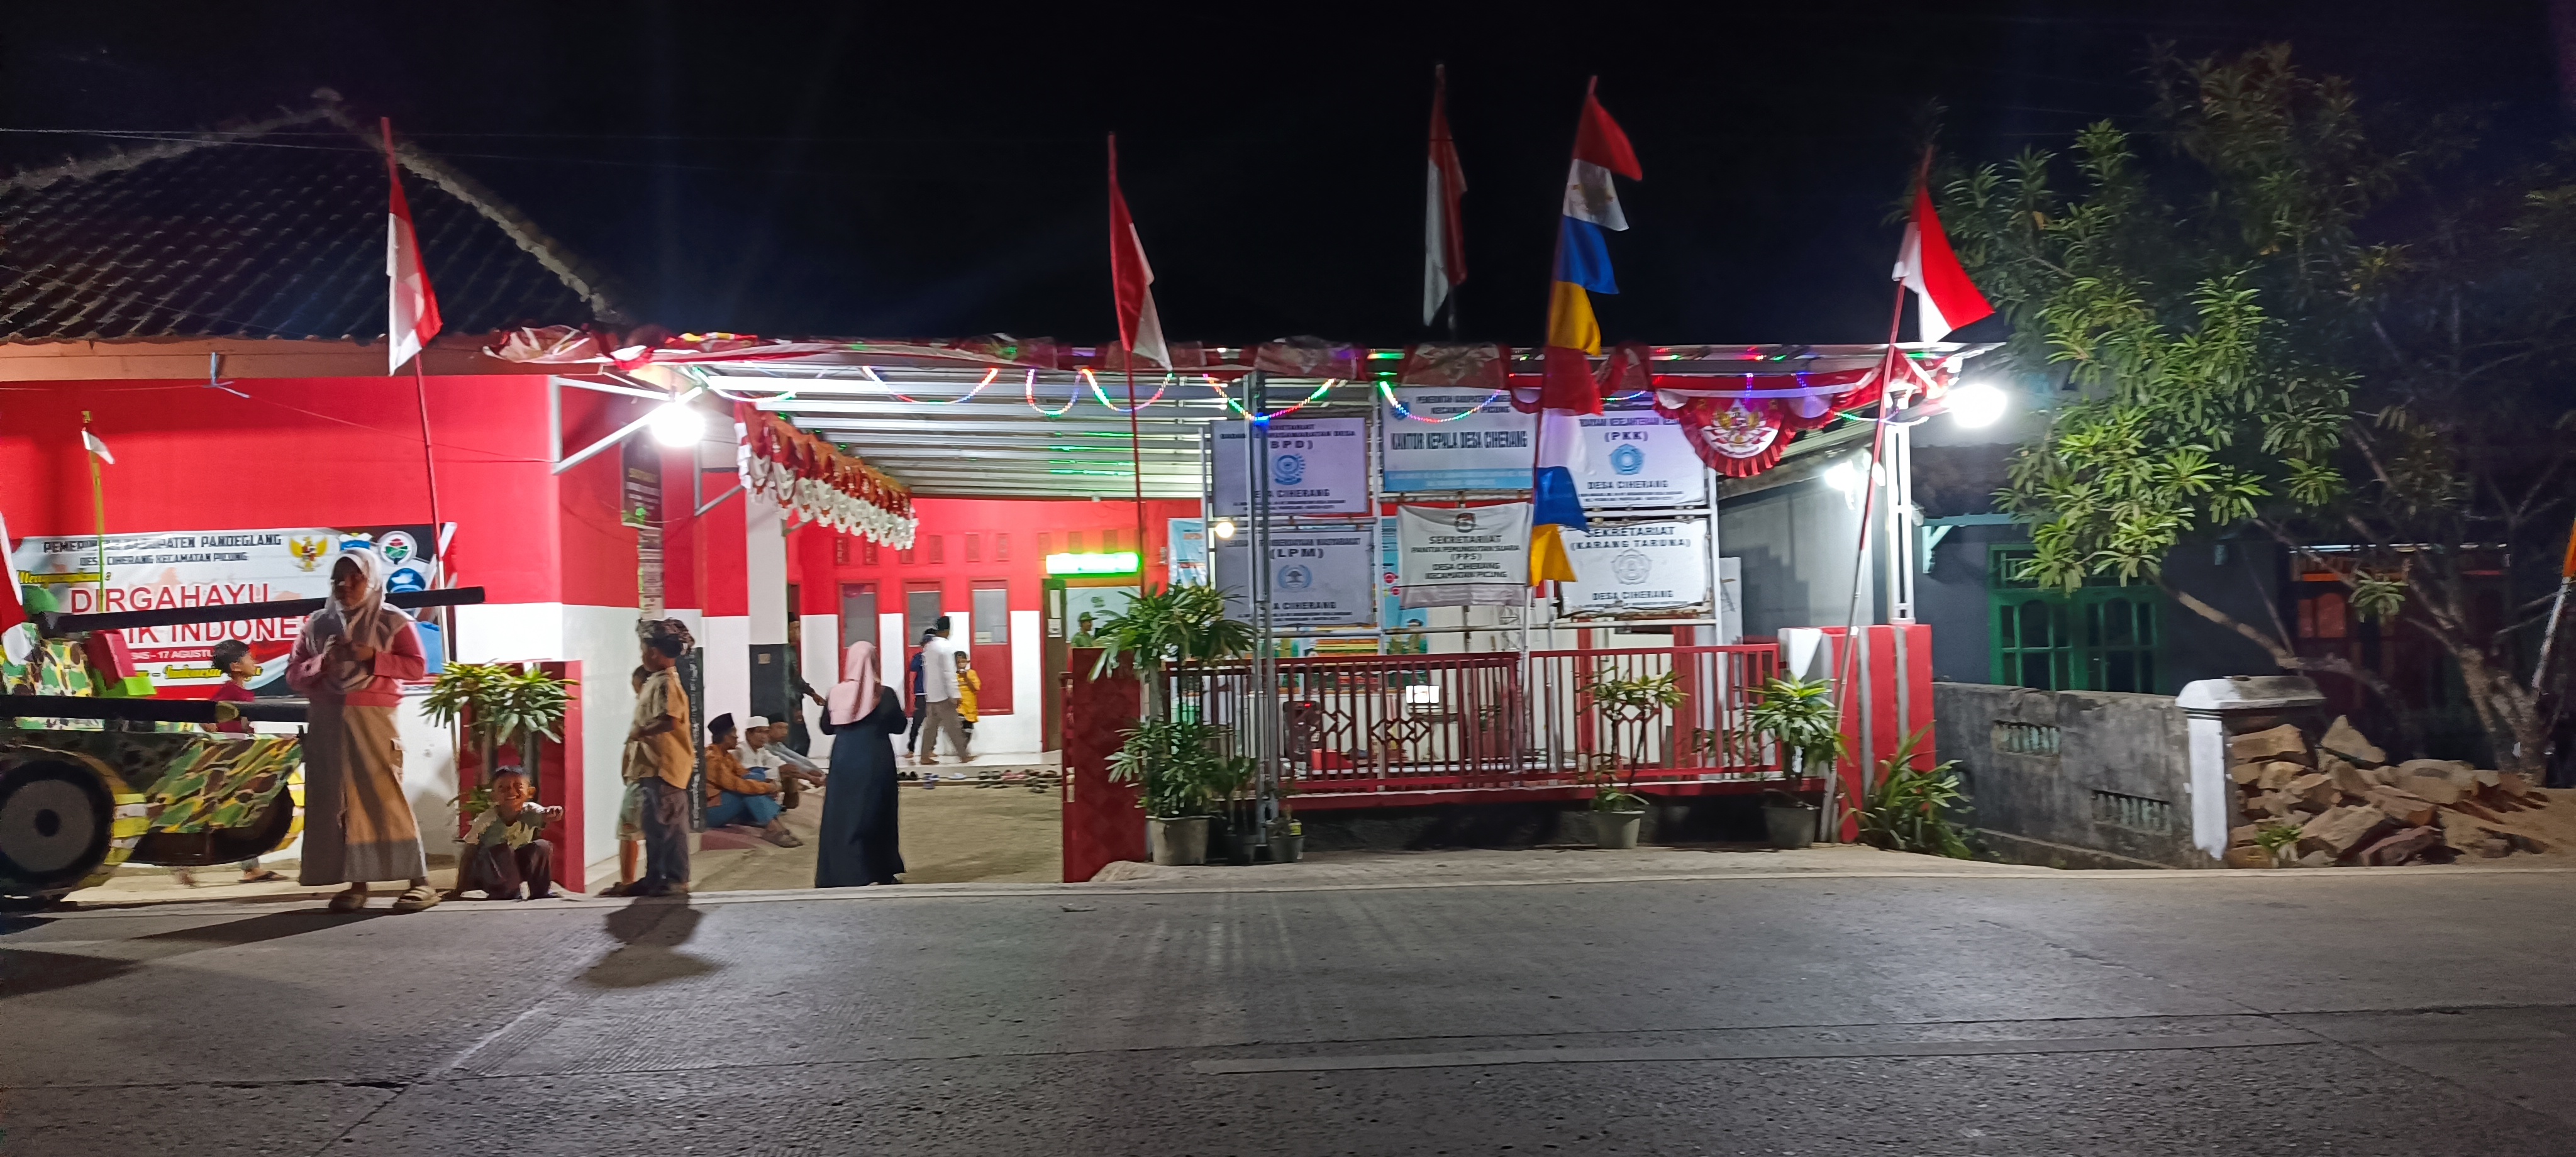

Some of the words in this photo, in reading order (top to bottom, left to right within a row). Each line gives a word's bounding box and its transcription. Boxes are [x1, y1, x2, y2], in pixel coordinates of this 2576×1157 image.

[1426, 431, 1459, 449] KEPALA
[1459, 431, 1482, 448] DESA
[1604, 431, 1648, 442] (PKK)
[1269, 440, 1314, 450] BPD)
[1616, 480, 1669, 488] CIHERANG
[1585, 526, 1675, 538] SEKRETARIAT
[201, 534, 282, 548] PANDEGLANG
[1428, 535, 1502, 544] SEKRETARIAT
[1269, 548, 1324, 559] (LPM)
[1450, 553, 1482, 562] (PPS)
[79, 557, 103, 566] DES
[70, 583, 269, 613] DIRGAHAYU
[1591, 592, 1619, 601] DESA
[1621, 590, 1674, 599] CIHERANG
[171, 616, 309, 643] INDONE
[159, 651, 170, 659] 17
[171, 650, 213, 658] AGUSTU
